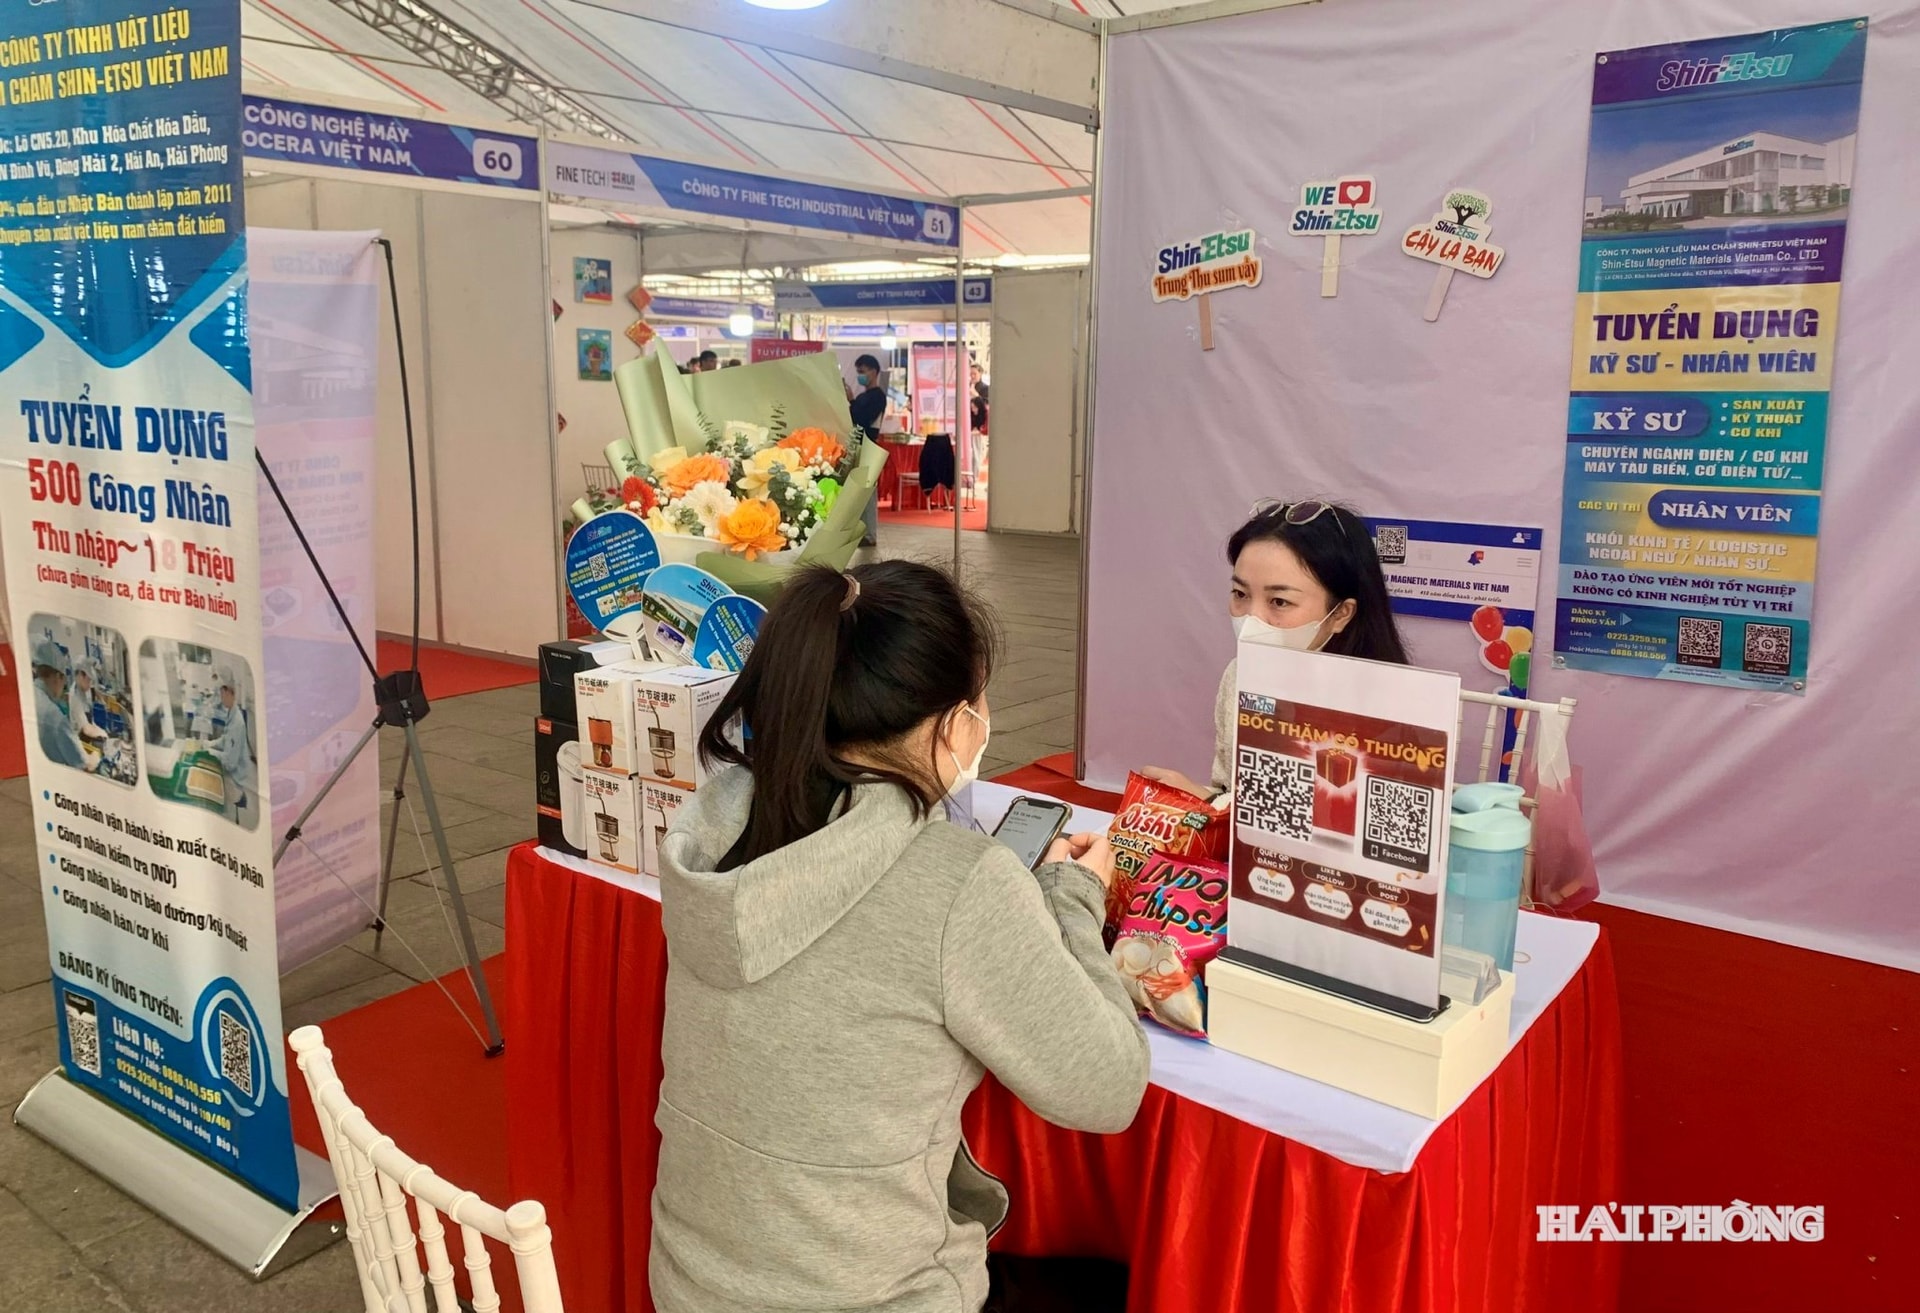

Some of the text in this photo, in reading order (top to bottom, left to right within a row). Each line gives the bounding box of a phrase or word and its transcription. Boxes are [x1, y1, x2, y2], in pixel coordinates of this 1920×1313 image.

[1, 6, 190, 67] CÔNG TY TNHH VẬT LIỆU
[58, 60, 143, 98] SHIN-ETSU
[146, 50, 184, 89] VIỆT
[189, 46, 229, 80] NAM
[244, 103, 410, 144] CÔNG NGHỆ MÁY
[72, 127, 98, 146] Khu
[242, 129, 411, 167] OCERA VIỆT NAM
[82, 153, 107, 172] Hải
[166, 145, 187, 166] Hải
[190, 143, 228, 164] Phòng
[483, 150, 513, 173] 60
[556, 165, 578, 183] FINE
[580, 168, 606, 187] TECH
[96, 183, 231, 211] Bản 2011
[682, 178, 720, 198] CÔNG
[721, 186, 739, 201] TY
[741, 190, 768, 206] FINE
[769, 194, 800, 211] TECH
[802, 199, 865, 220] INDUSTRIAL
[892, 213, 915, 227] NAM
[1305, 186, 1336, 206] WE
[931, 218, 945, 234] 51
[1806, 237, 1828, 246] NAM
[1601, 249, 1820, 270] Shin-Etsu Magnetic Materials Vietnam LTD
[968, 286, 982, 297] 43
[1593, 303, 1818, 343] TUYỂN DỤNG
[1626, 351, 1661, 374] SƯ
[1682, 350, 1749, 374] NHÂN
[1758, 349, 1816, 373] VIÊN
[20, 383, 228, 465] TUYỂN DỤNG
[1592, 407, 1687, 431] KỸ SƯ
[28, 458, 82, 507] 500
[88, 473, 156, 524] Công
[164, 479, 231, 527] Nhân
[1661, 501, 1792, 522] NHÂN VIÊN
[32, 520, 70, 555] Thu
[182, 541, 235, 587] Triệu
[1628, 534, 1788, 556] KINH LOGISTIC
[116, 582, 134, 602] ca,
[1391, 574, 1510, 594] MAGNETIC MATERIALS VIET NAM
[1573, 585, 1614, 597] KHÔNG
[1636, 590, 1667, 601] KINH
[1670, 593, 1719, 607] NGHIỆM
[1658, 576, 1688, 587] VIÊN
[1746, 584, 1796, 597] NGHIỆP
[1239, 711, 1274, 733] BỐC
[1278, 721, 1328, 744] THĂM
[54, 792, 79, 816] Công
[176, 838, 208, 858] xuất
[57, 824, 82, 848] Công
[1119, 807, 1180, 843] Oishi
[1382, 848, 1417, 864] Facebook
[60, 857, 85, 881] Công
[1316, 873, 1345, 886] FOLLOW
[1140, 861, 1228, 903] INDO
[63, 889, 88, 913] Công
[1380, 892, 1399, 901] POST
[59, 951, 184, 1028] ĐĂNG KÝ ỨNG TUYỂN:
